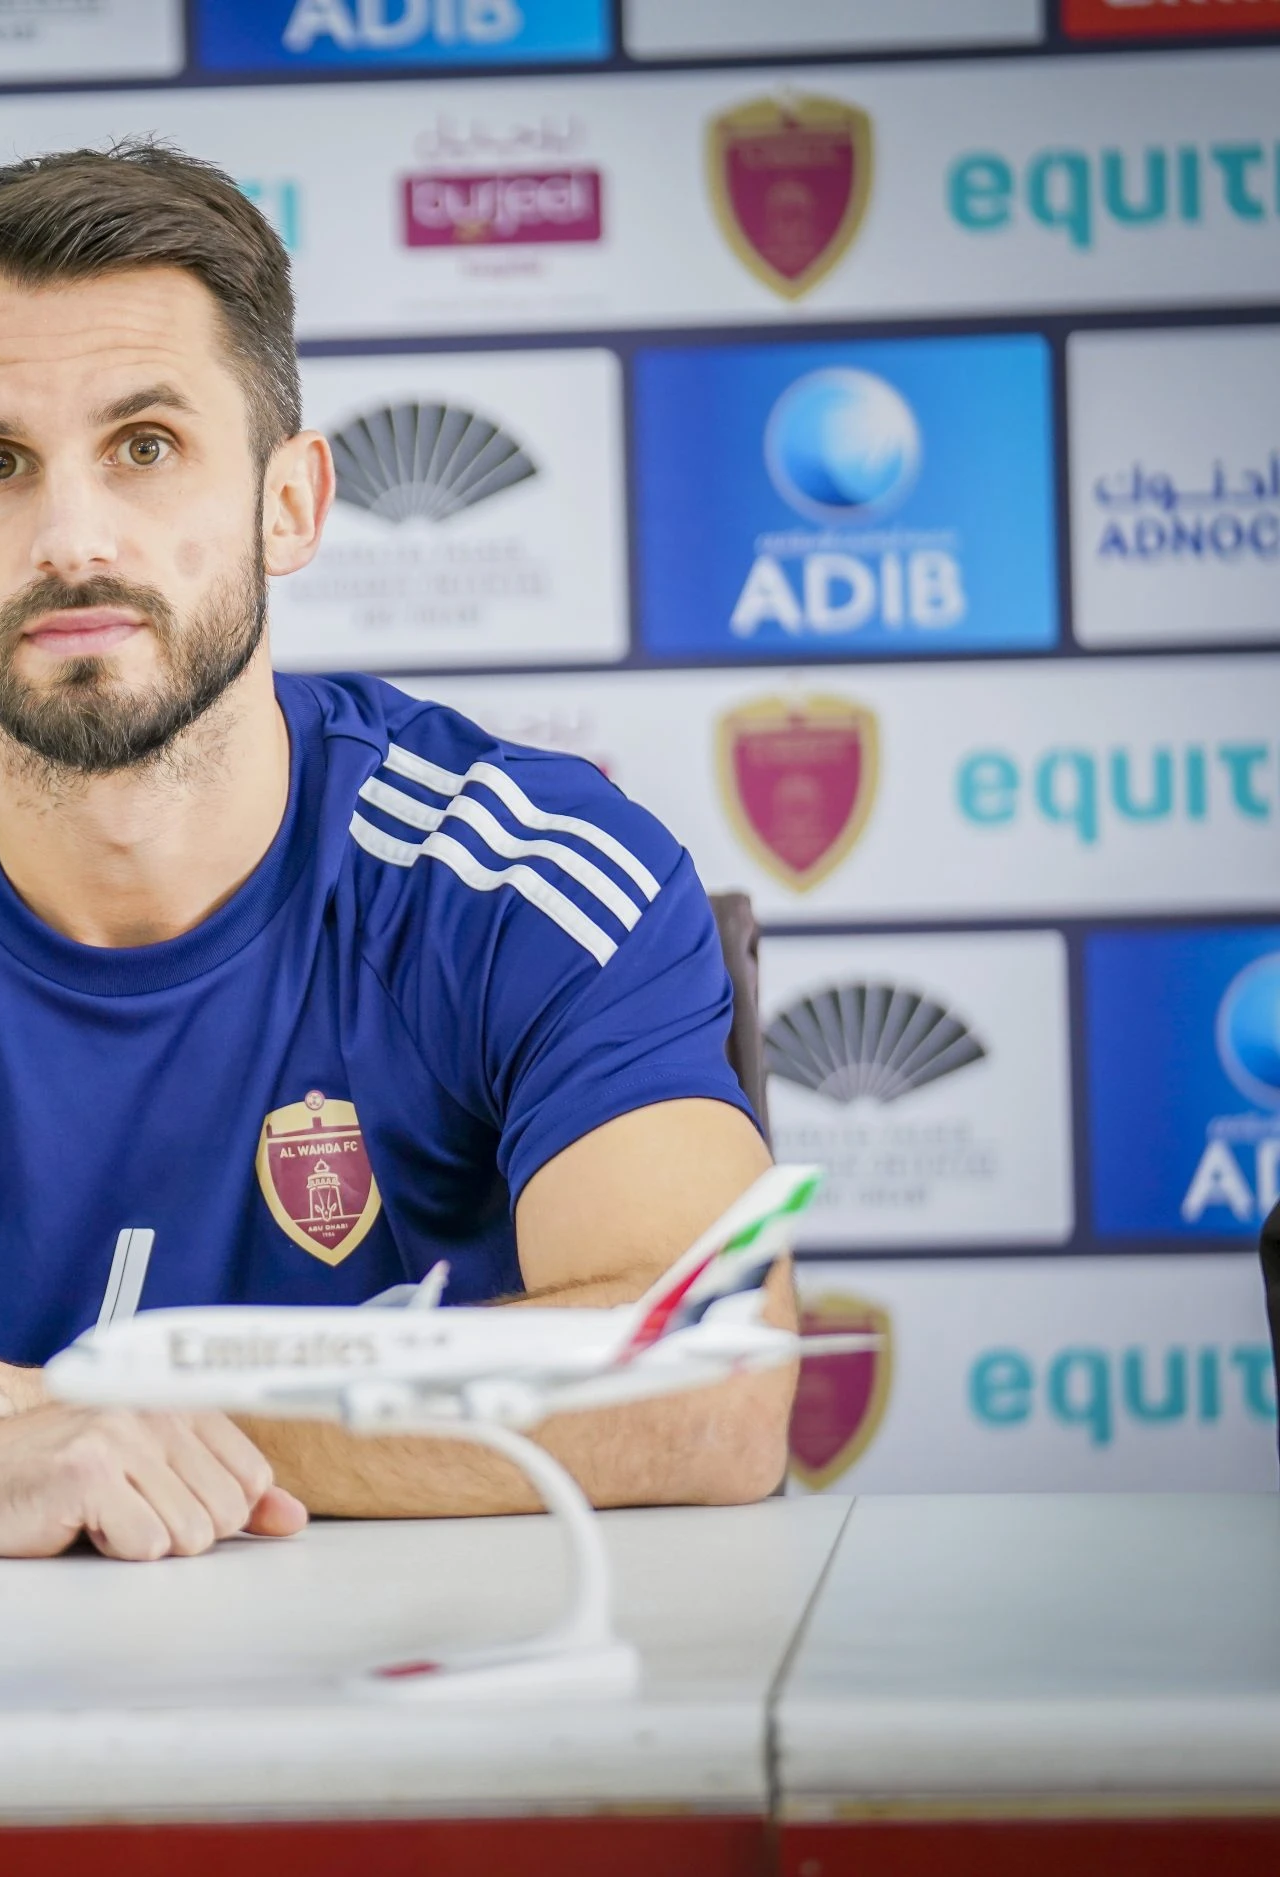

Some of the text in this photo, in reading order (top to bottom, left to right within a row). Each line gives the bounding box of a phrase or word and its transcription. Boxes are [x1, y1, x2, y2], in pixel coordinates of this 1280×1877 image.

[282, 0, 525, 52] ADIB
[1098, 514, 1280, 562] ADNOC
[730, 549, 967, 639] ADIB
[954, 740, 1280, 845] equit
[280, 1140, 358, 1158] AL WAHDA FC
[325, 1223, 349, 1231] DHABI
[967, 1342, 1277, 1447] equit
